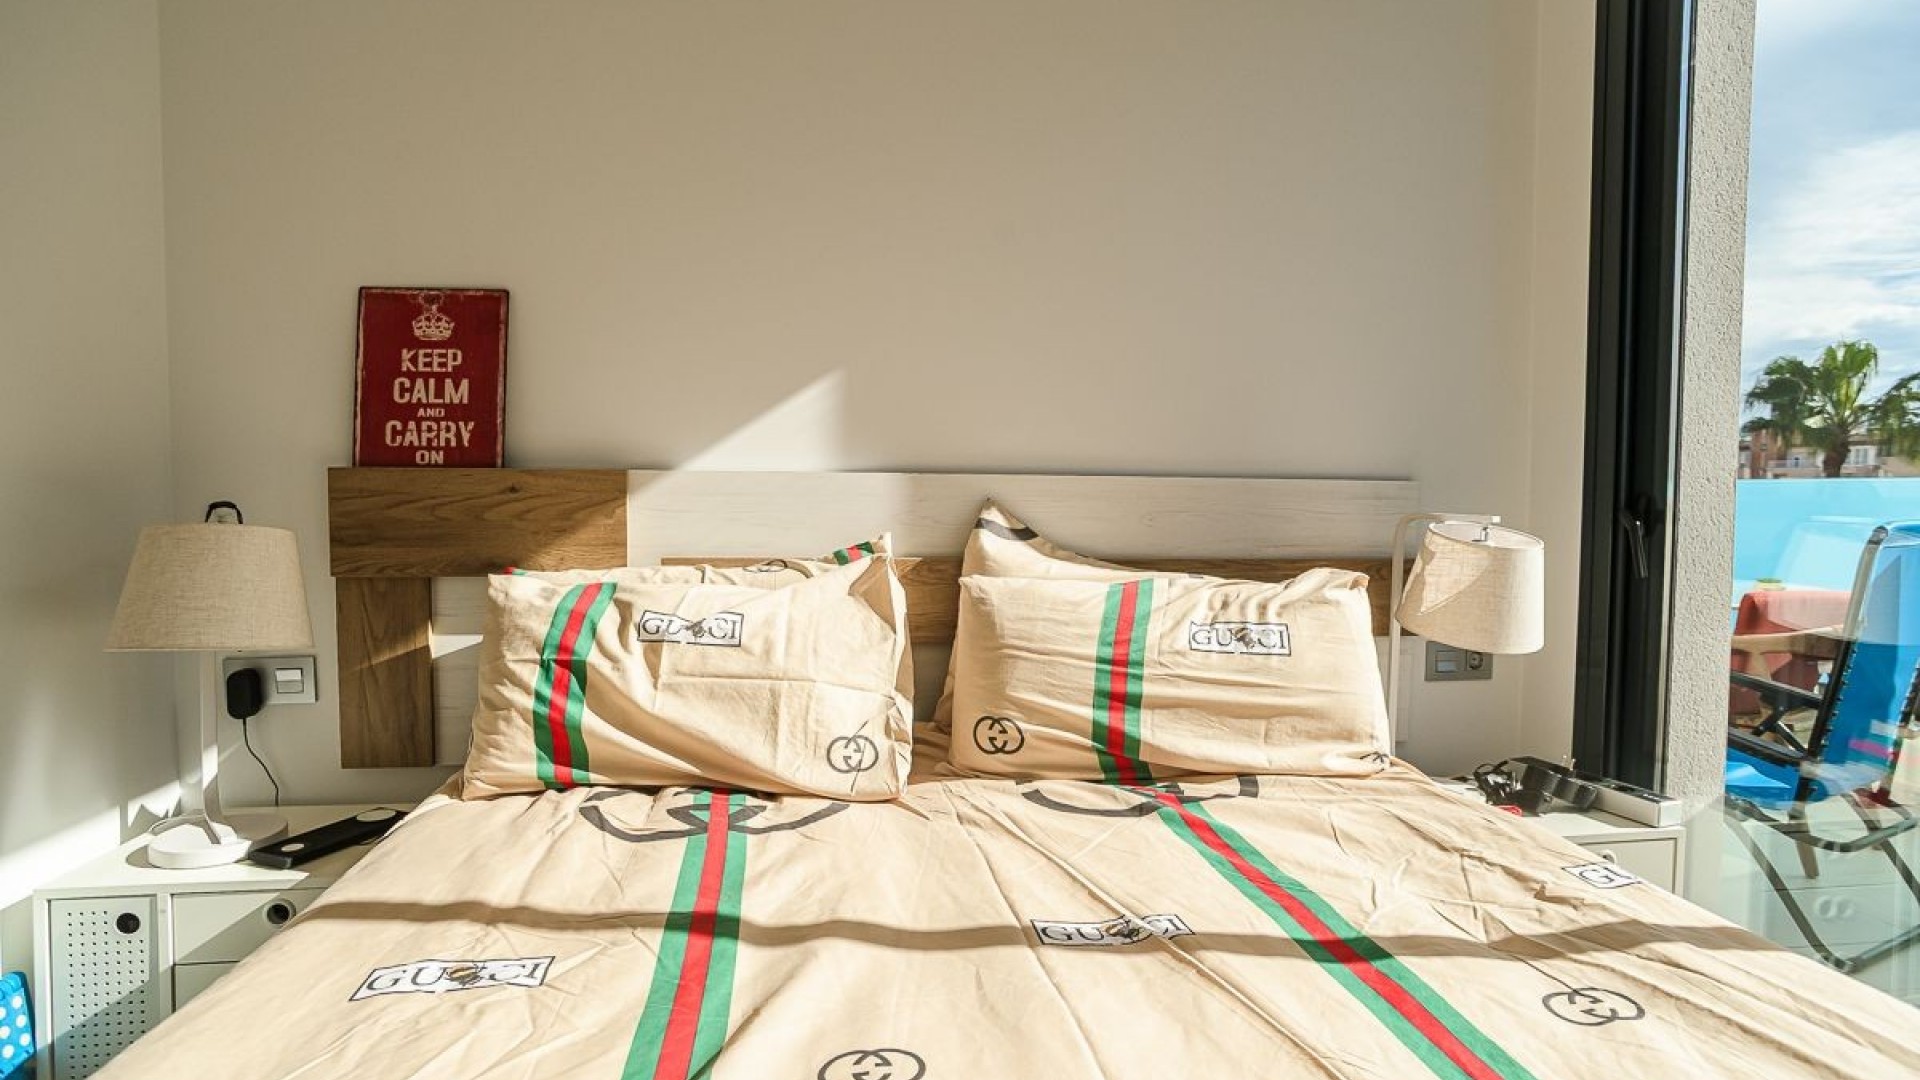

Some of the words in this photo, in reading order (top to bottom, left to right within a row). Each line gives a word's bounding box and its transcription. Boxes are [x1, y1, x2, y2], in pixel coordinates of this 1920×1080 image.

[401, 349, 463, 373] KEEP
[393, 377, 470, 404] CALM
[417, 408, 446, 418] AND
[385, 420, 475, 447] CARRY
[415, 450, 444, 465] ON
[641, 616, 738, 640] GUCI
[1191, 627, 1287, 650] GUCI
[1040, 917, 1186, 941] GUCI
[366, 961, 546, 991] GUCI
